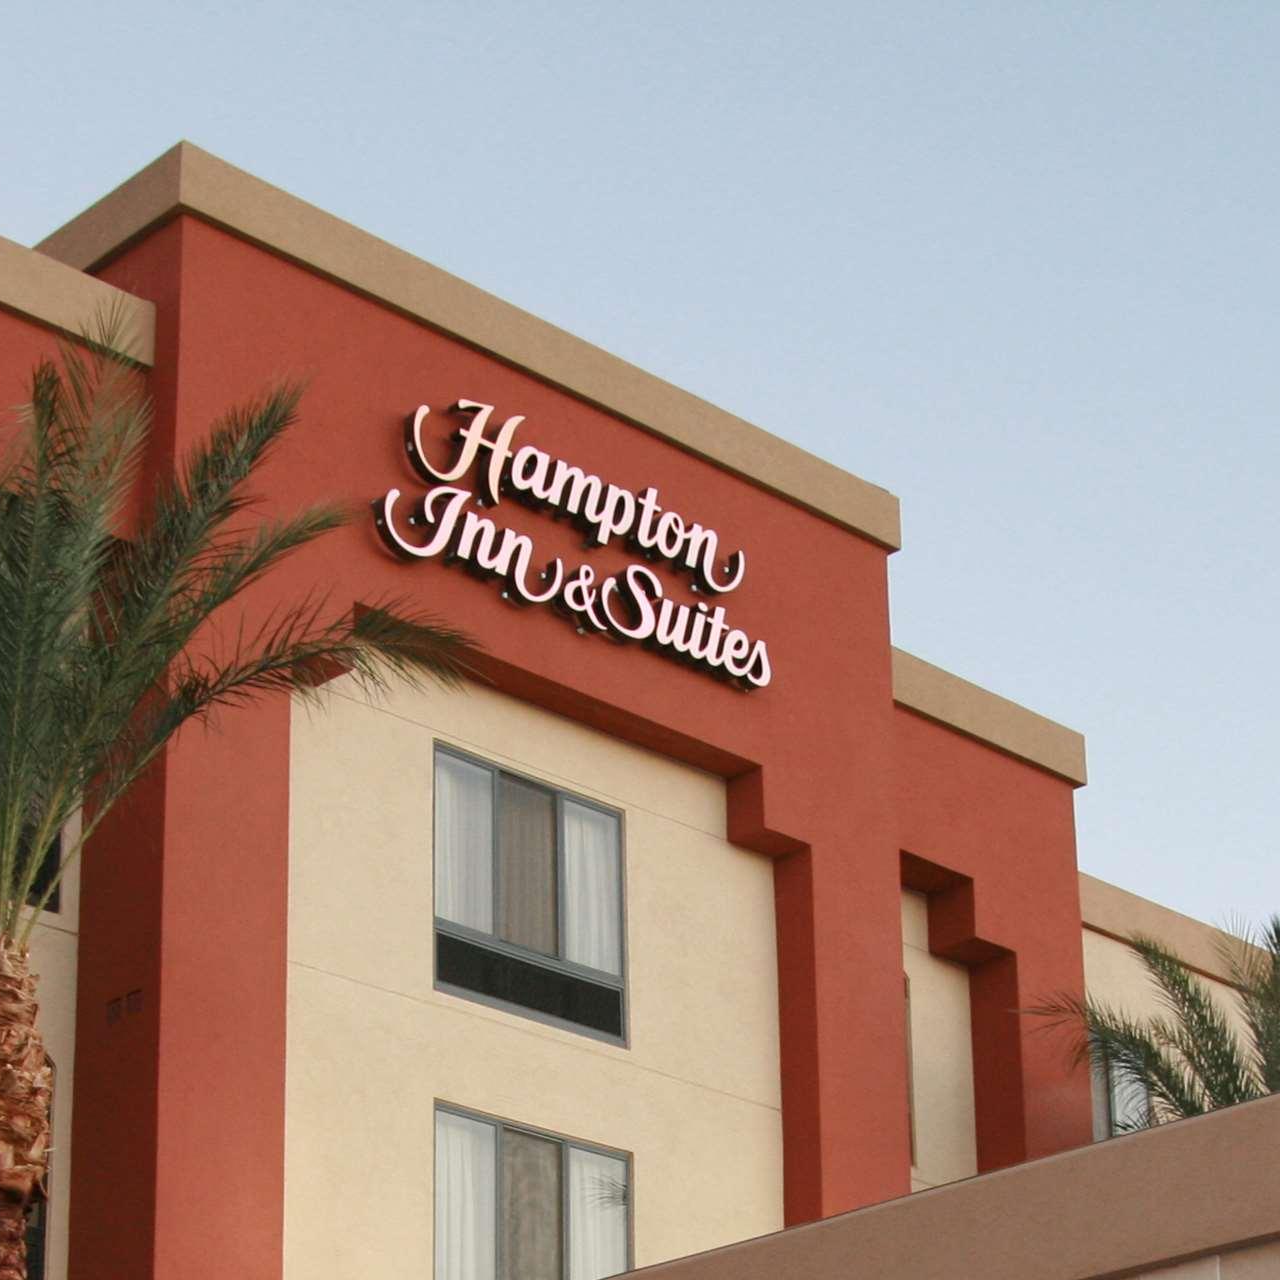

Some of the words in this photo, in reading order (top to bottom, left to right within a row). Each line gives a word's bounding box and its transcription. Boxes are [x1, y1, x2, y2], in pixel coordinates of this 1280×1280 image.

[383, 485, 564, 604] Inn
[563, 564, 608, 632] &
[601, 563, 773, 688] Suites
[412, 397, 746, 594] Hampton
